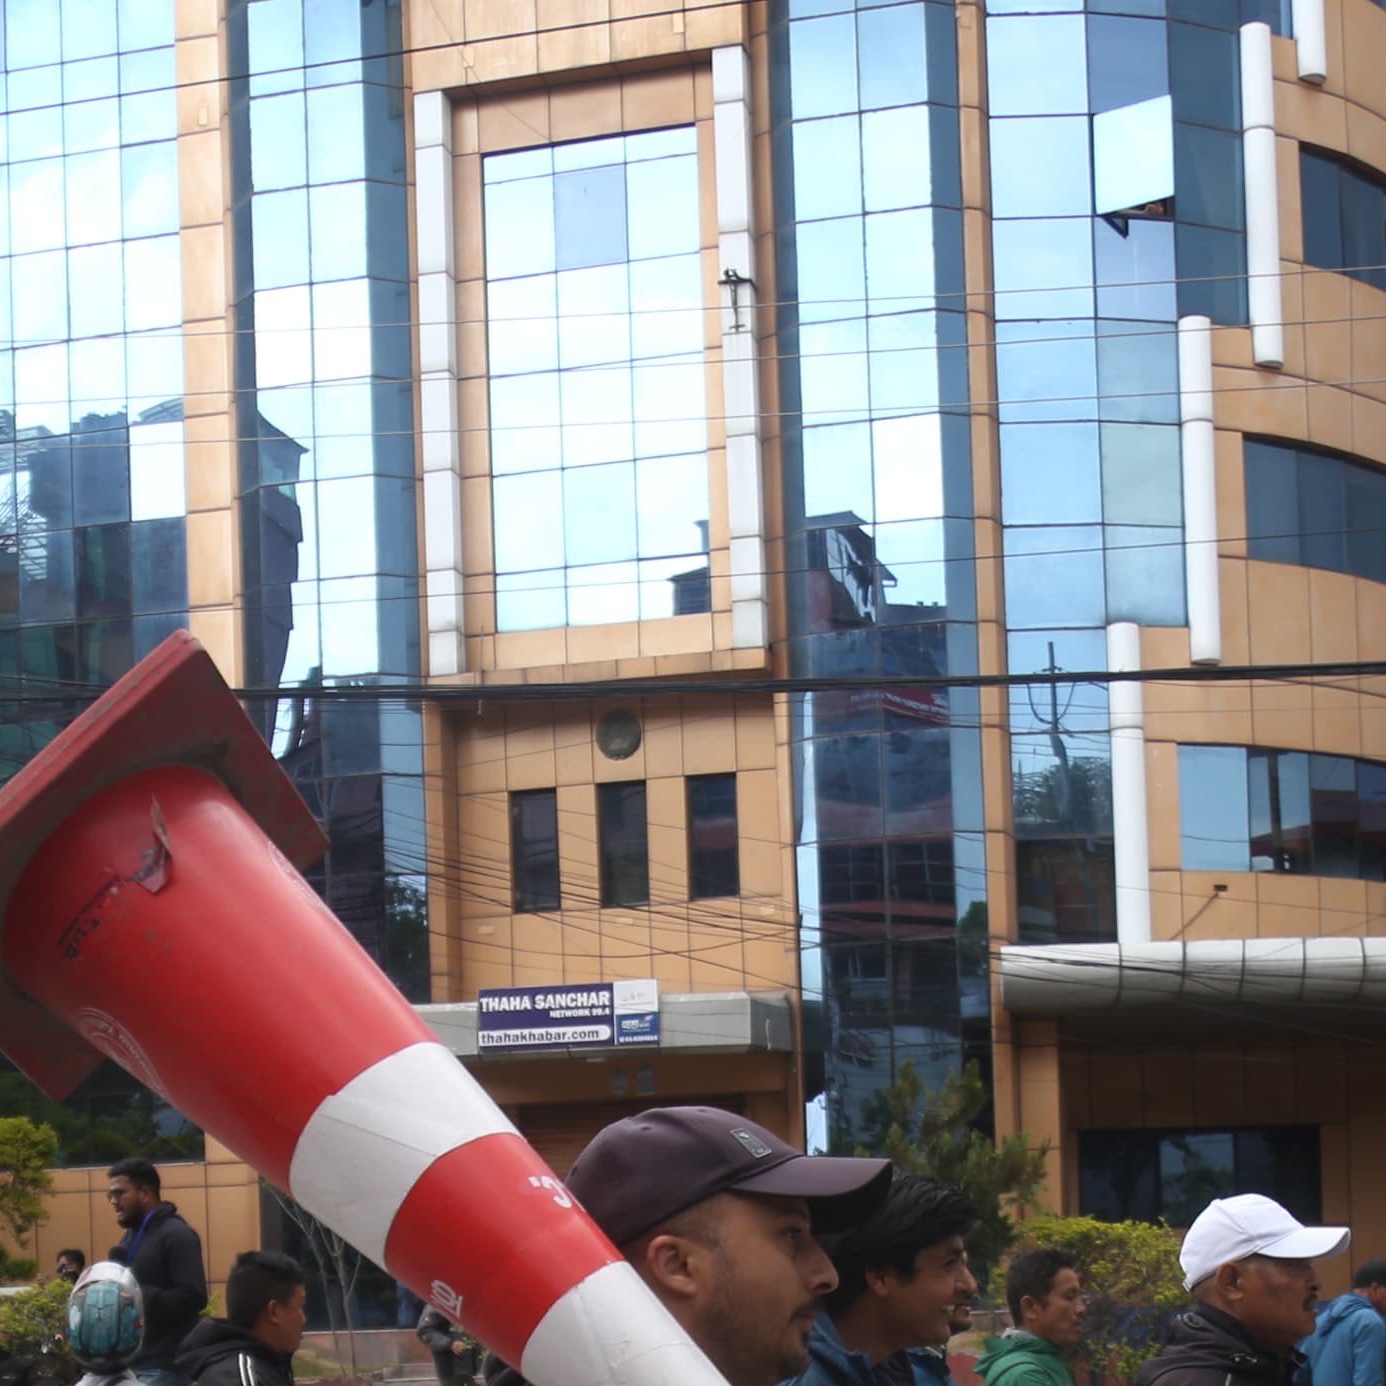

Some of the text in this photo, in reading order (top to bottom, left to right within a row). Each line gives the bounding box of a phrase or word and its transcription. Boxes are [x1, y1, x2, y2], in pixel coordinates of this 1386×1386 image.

[480, 995, 531, 1012] THAHA
[535, 991, 611, 1010] SANCHAR
[549, 1008, 611, 1019] NETWORK 99.4
[480, 1027, 600, 1045] thahakhabar.com
